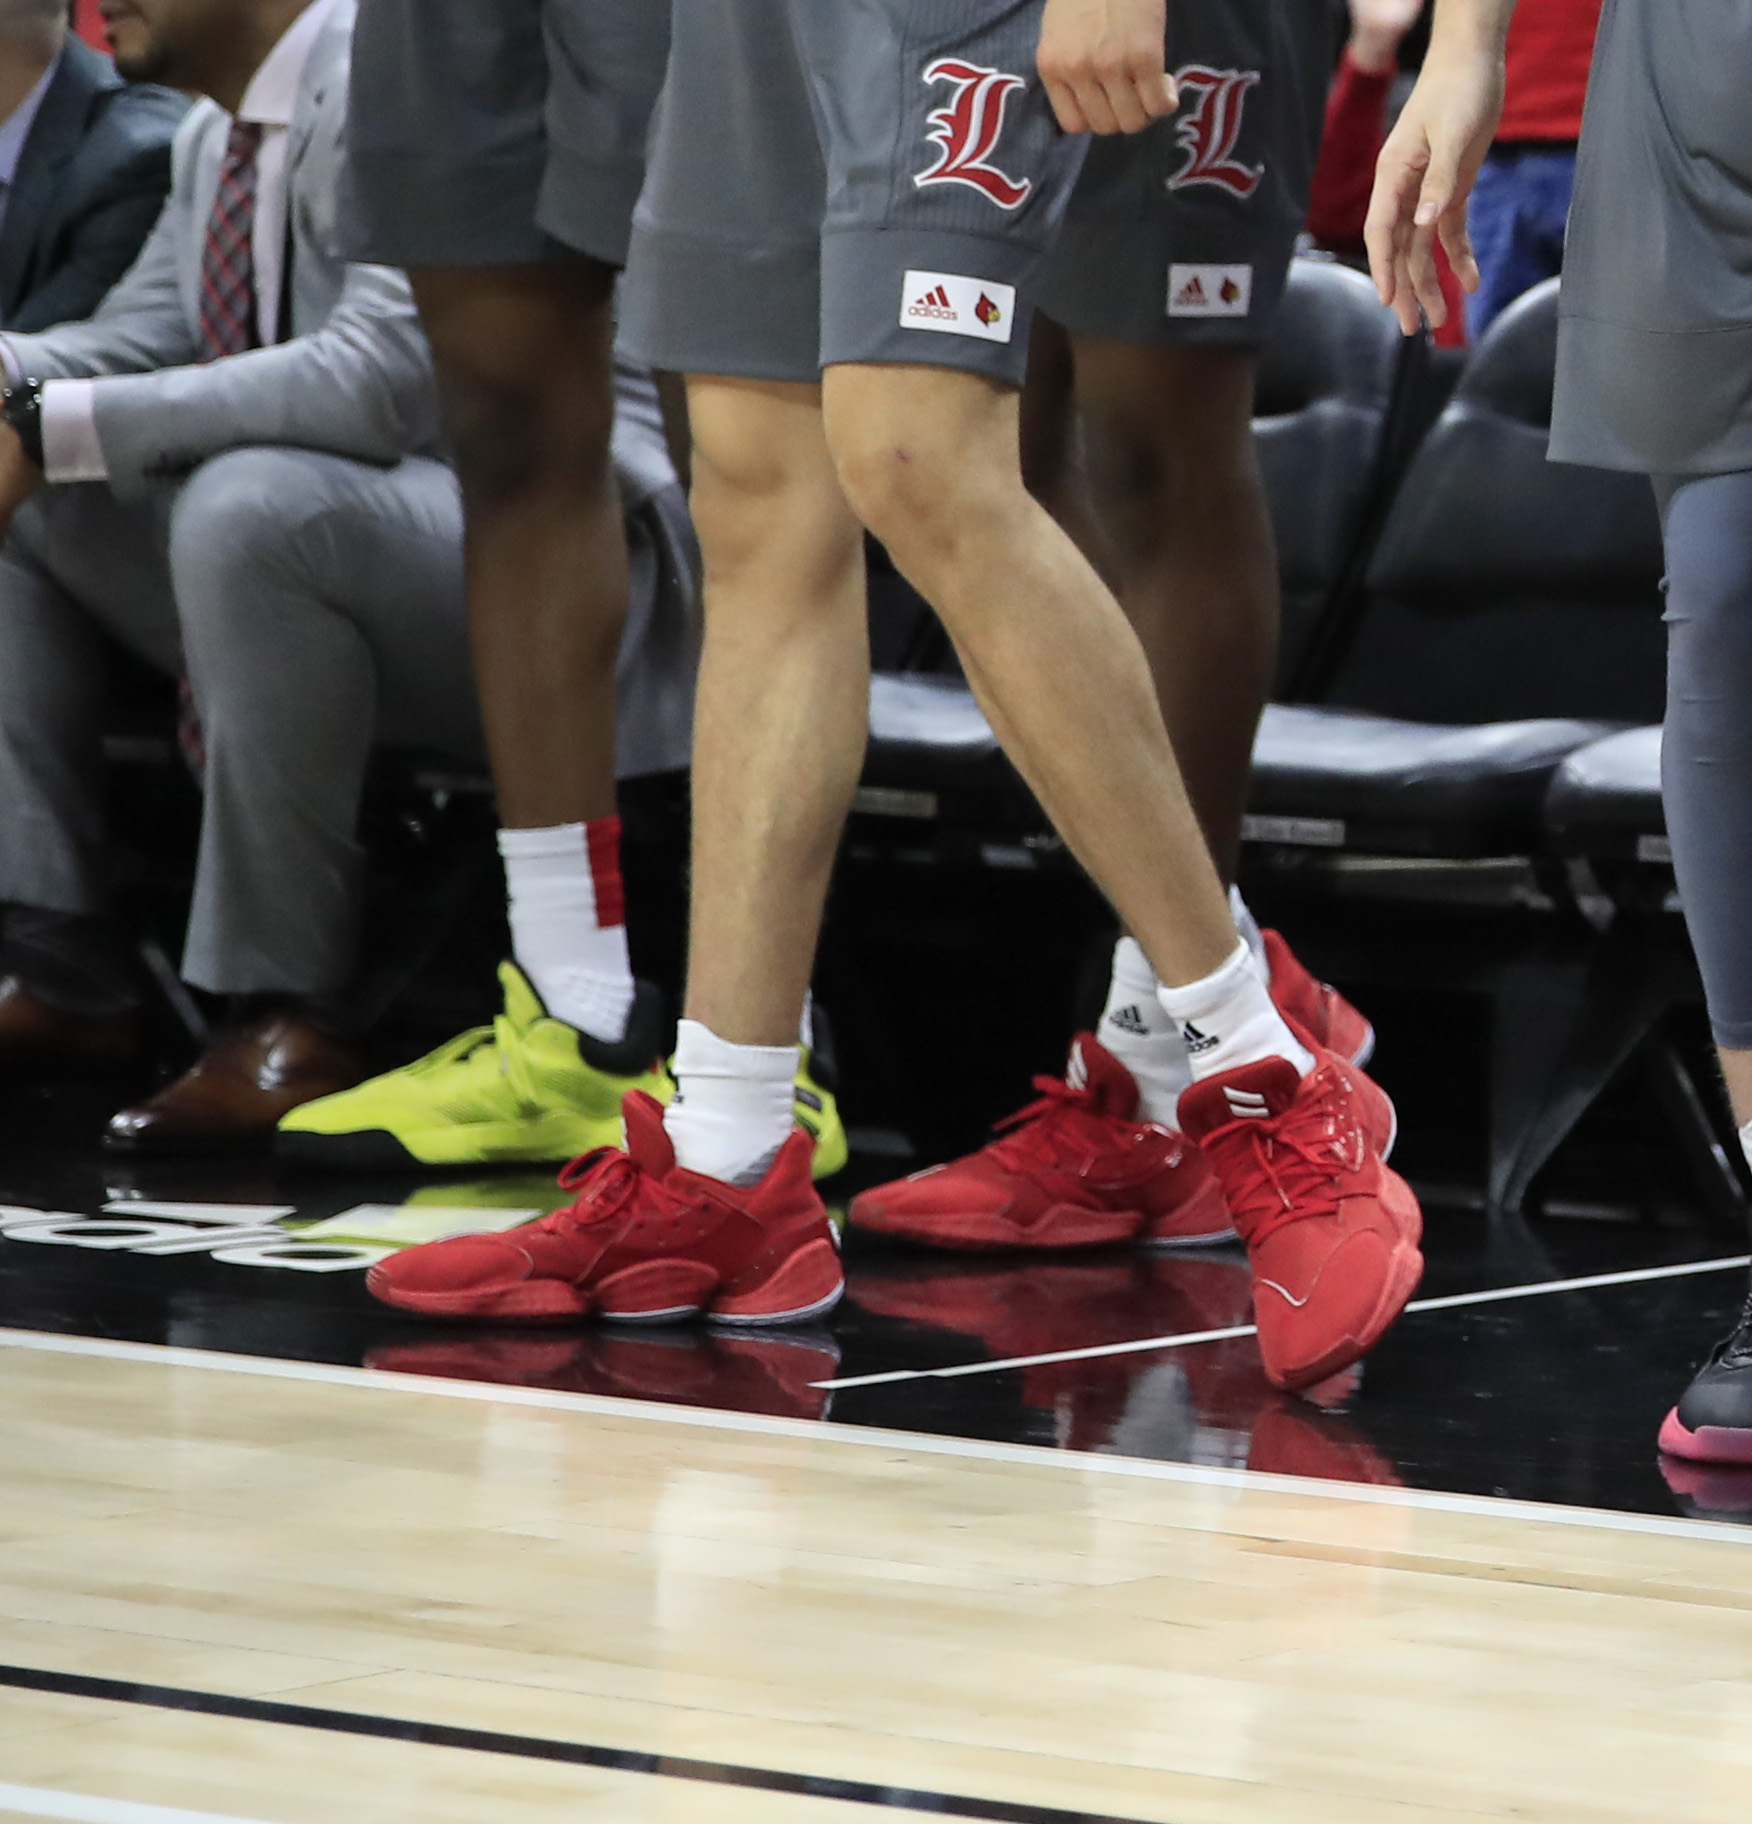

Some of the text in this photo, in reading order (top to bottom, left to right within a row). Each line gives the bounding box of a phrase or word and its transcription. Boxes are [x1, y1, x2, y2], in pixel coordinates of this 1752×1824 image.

[914, 56, 1032, 212] L
[1166, 64, 1266, 200] L
[907, 304, 959, 321] adidas
